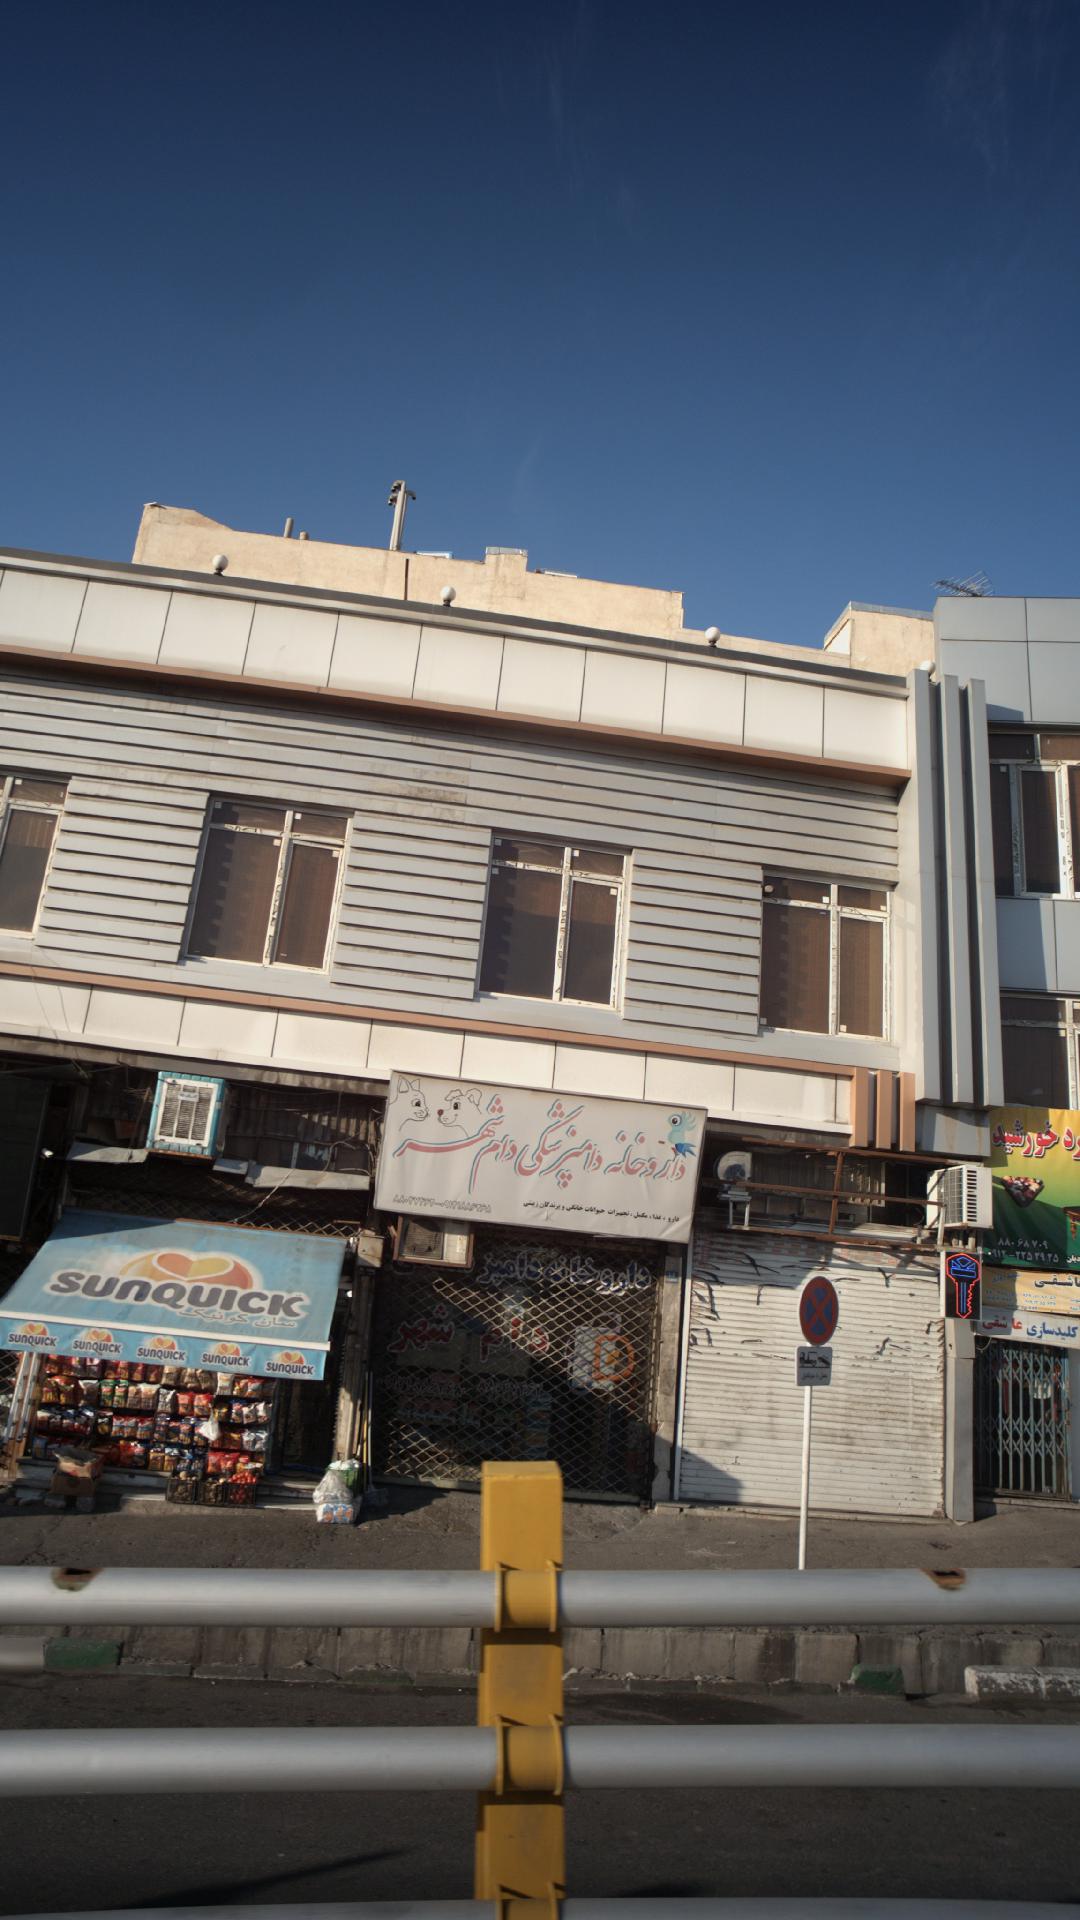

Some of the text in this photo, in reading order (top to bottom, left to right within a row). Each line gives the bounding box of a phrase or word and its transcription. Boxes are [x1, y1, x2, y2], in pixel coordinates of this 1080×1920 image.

[393, 1094, 686, 1194] داروخانه دامپزشکی دام شهر
[992, 1120, 1059, 1158] خورشید
[1034, 1273, 1080, 1288] اشقی
[49, 1271, 306, 1317] SUNQUICK
[982, 1316, 1078, 1340] کلیدسازی عاشقی
[8, 1333, 58, 1348] SUNQUICK
[73, 1340, 122, 1354] SUNQUICK
[137, 1347, 186, 1361] SUNQUICK
[202, 1353, 250, 1367] SUNQUICK
[266, 1361, 314, 1376] SUNQUICK
